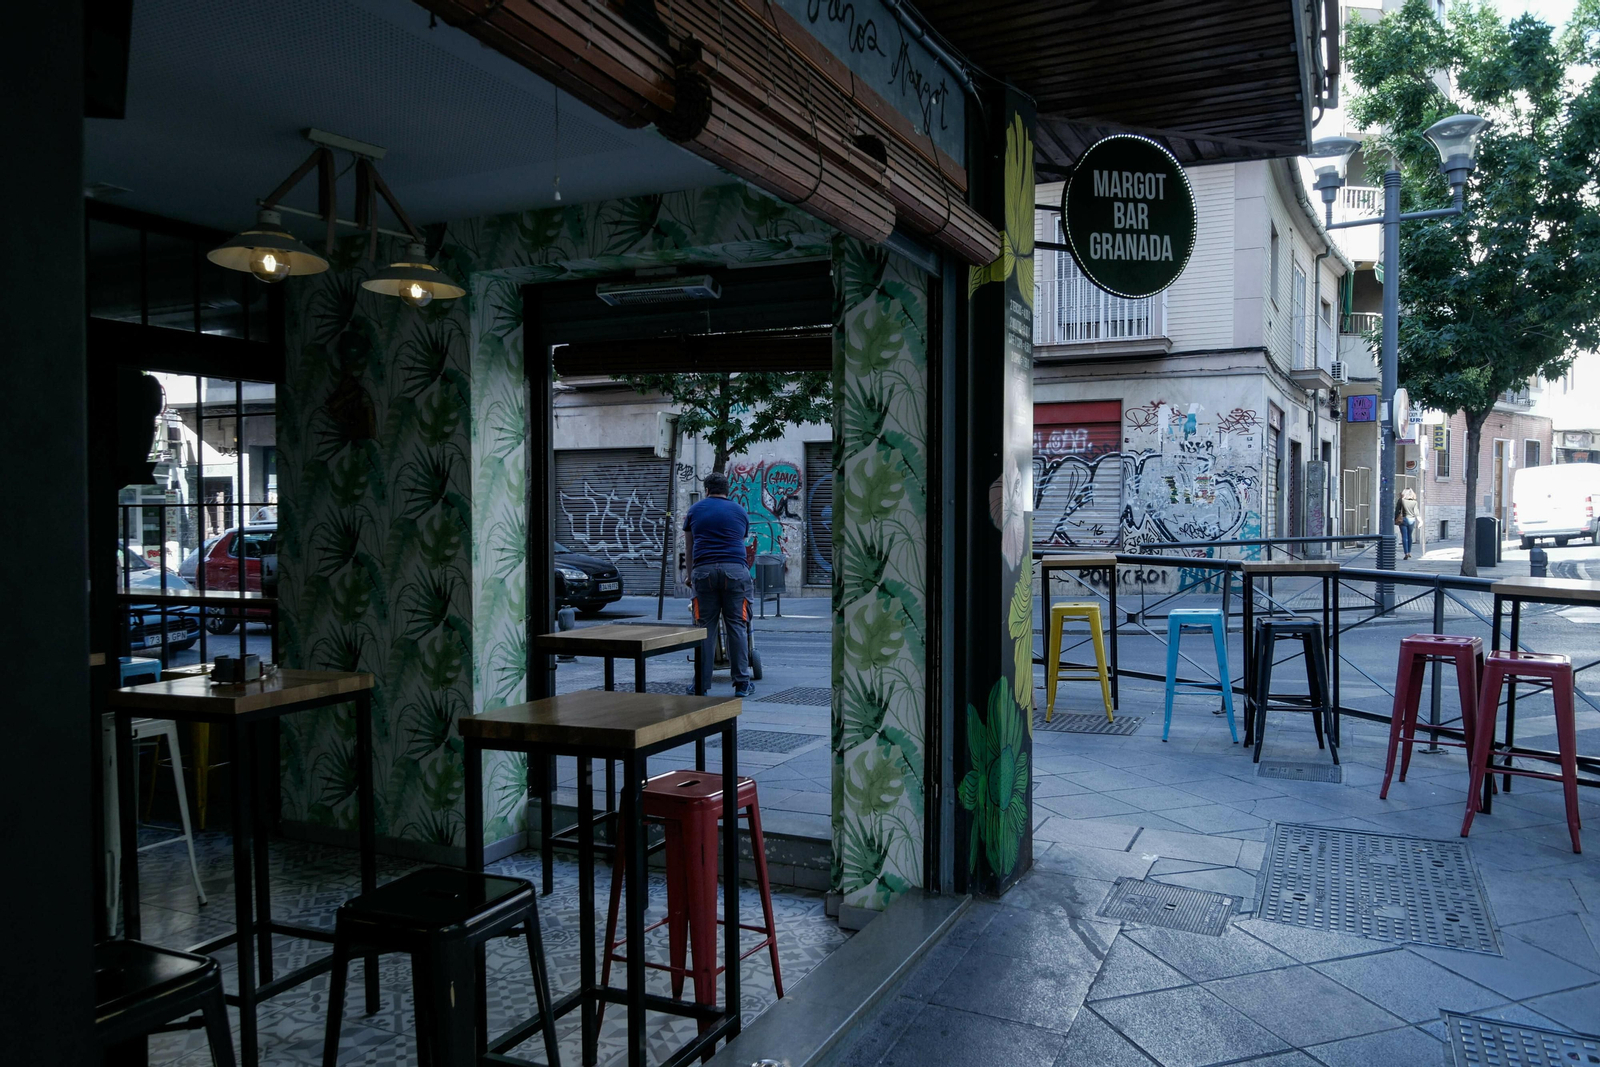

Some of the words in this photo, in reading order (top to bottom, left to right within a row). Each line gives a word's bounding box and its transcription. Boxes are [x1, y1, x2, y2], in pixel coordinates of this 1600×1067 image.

[1093, 170, 1167, 201] MARGOT
[1113, 202, 1149, 230] BAR
[1090, 232, 1174, 261] GRANADA
